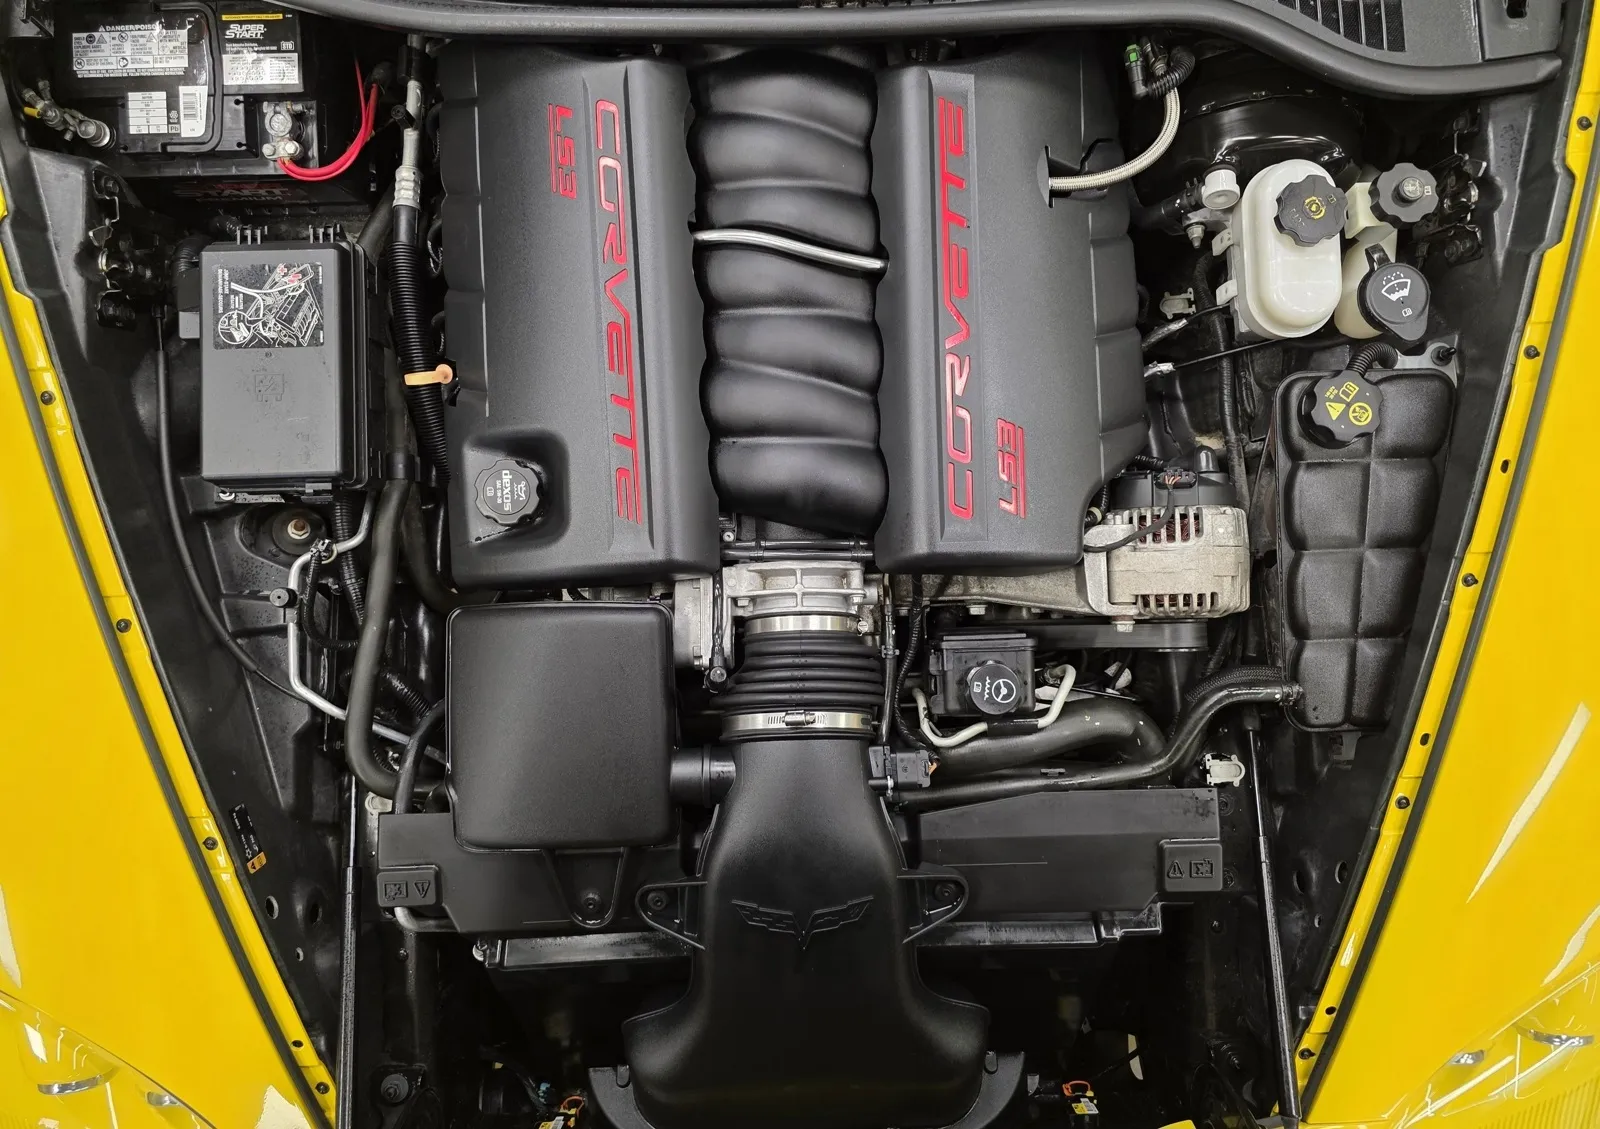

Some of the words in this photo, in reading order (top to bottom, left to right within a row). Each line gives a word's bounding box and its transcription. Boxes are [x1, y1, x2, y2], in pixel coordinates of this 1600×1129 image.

[224, 30, 265, 39] START
[554, 103, 577, 199] LS3
[595, 99, 643, 525] CORVETTE
[938, 96, 974, 520] CORVETTE
[502, 470, 513, 512] dexos
[996, 417, 1019, 516] LS3
